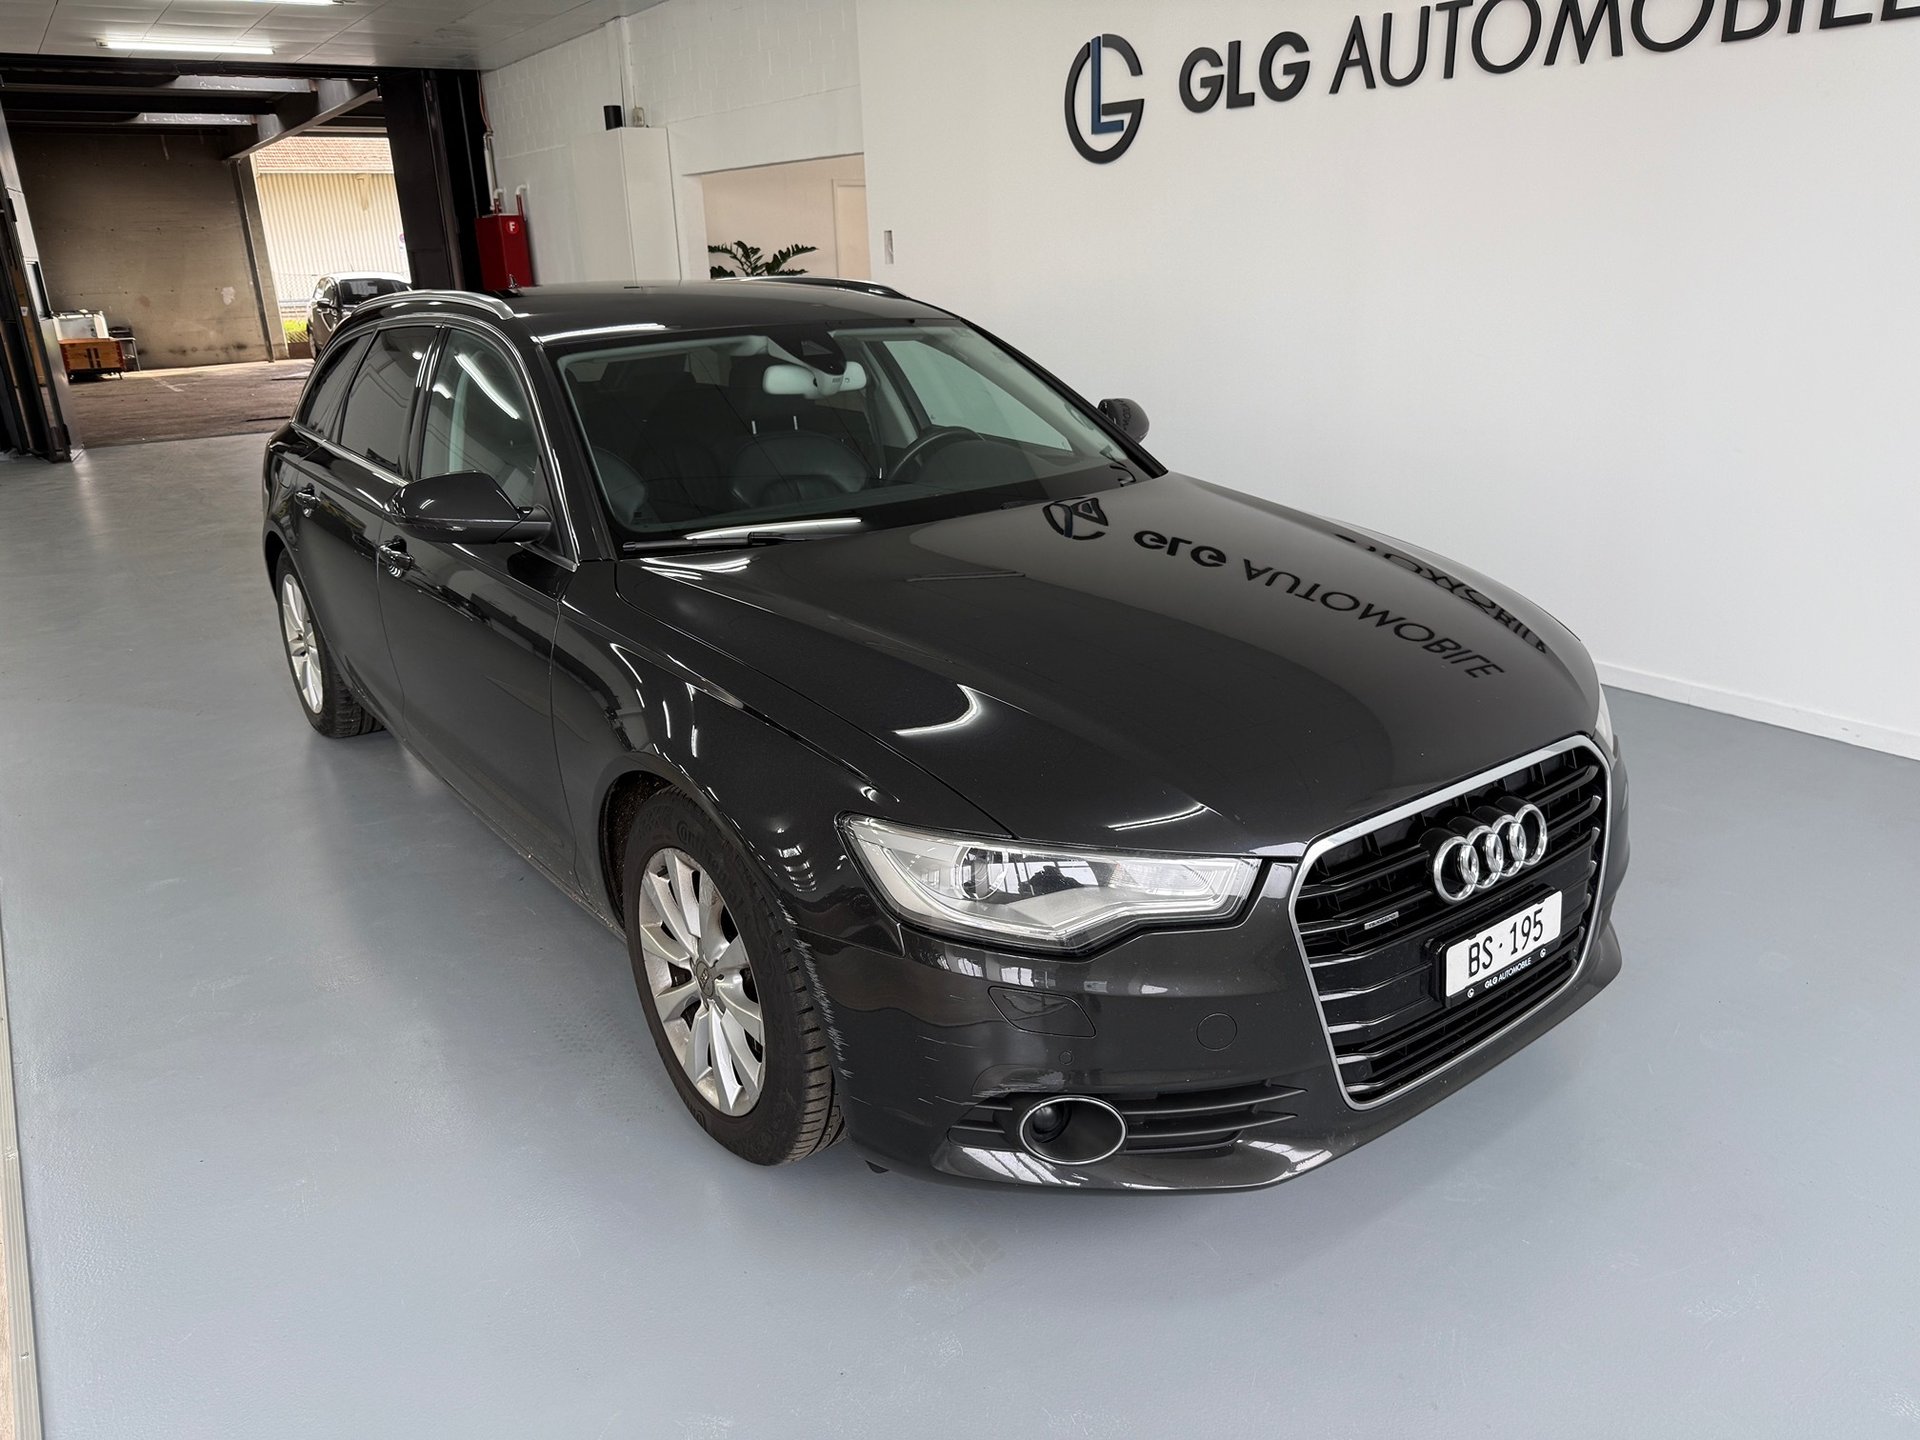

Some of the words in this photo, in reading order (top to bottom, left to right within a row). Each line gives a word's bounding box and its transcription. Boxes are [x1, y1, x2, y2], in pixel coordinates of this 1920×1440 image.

[1179, 31, 1309, 113] GLG
[1328, 0, 1920, 94] AUTOMO
[508, 221, 516, 232] F
[1484, 976, 1498, 989] GLG
[1498, 957, 1532, 982] AUTOMOBILE
